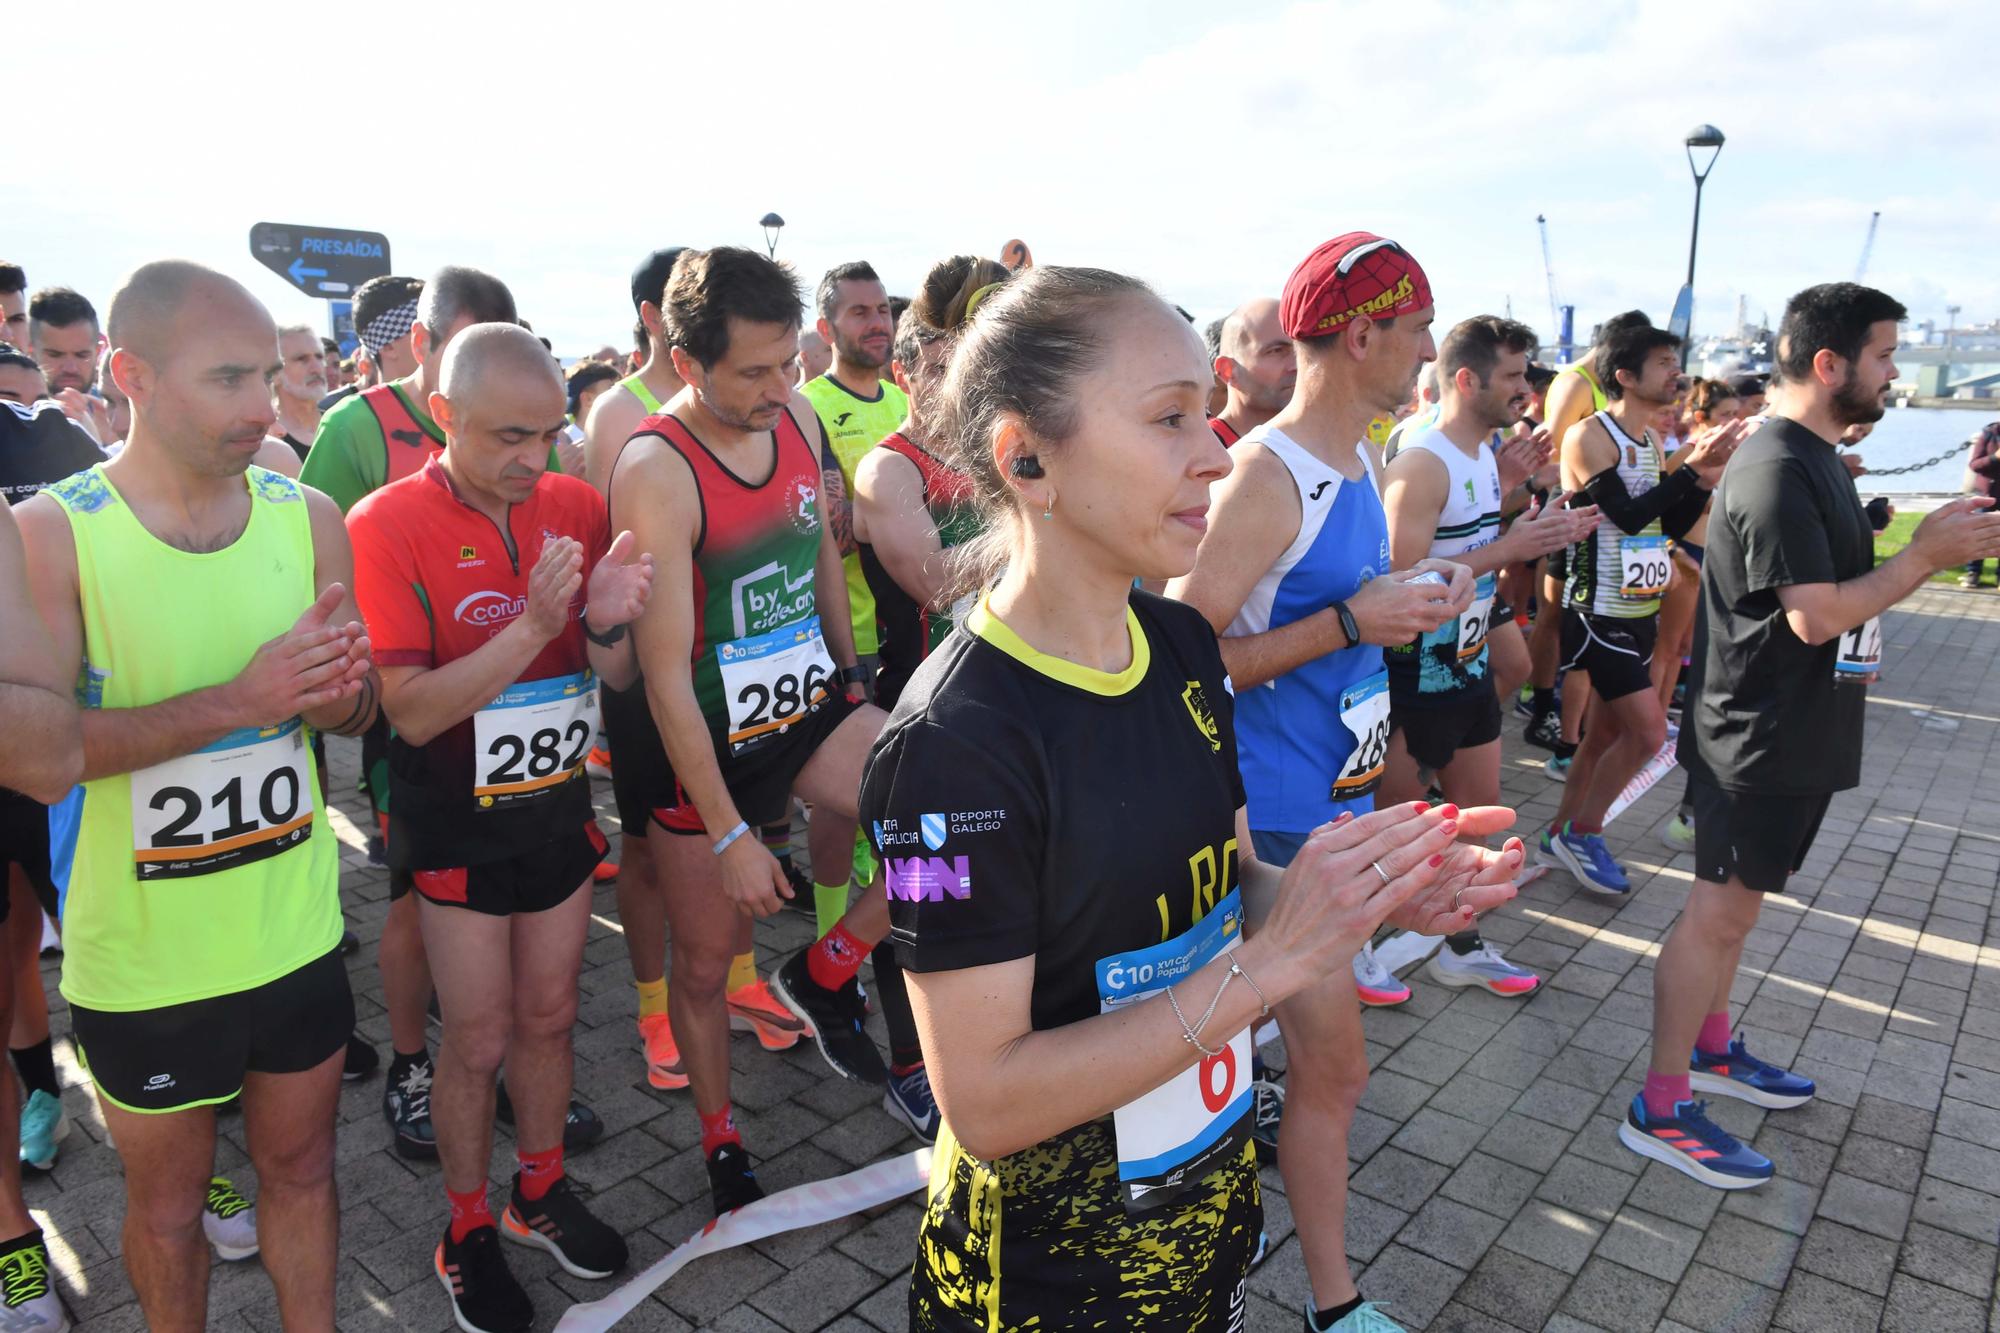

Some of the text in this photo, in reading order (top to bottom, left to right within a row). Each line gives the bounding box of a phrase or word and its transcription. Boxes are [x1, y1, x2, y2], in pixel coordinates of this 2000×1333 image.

[301, 237, 383, 258] PRESAÍDA
[1012, 244, 1026, 270] 2
[1627, 561, 1668, 588] 209
[472, 595, 529, 622] coruñ
[748, 588, 779, 612] by
[737, 664, 827, 730] 286
[487, 719, 590, 785] 282
[149, 766, 299, 848] 210
[951, 810, 1006, 822] DEPORTE
[884, 832, 919, 845] GALICIA
[952, 821, 1001, 834] GALEGO
[1157, 959, 1175, 970] XVI
